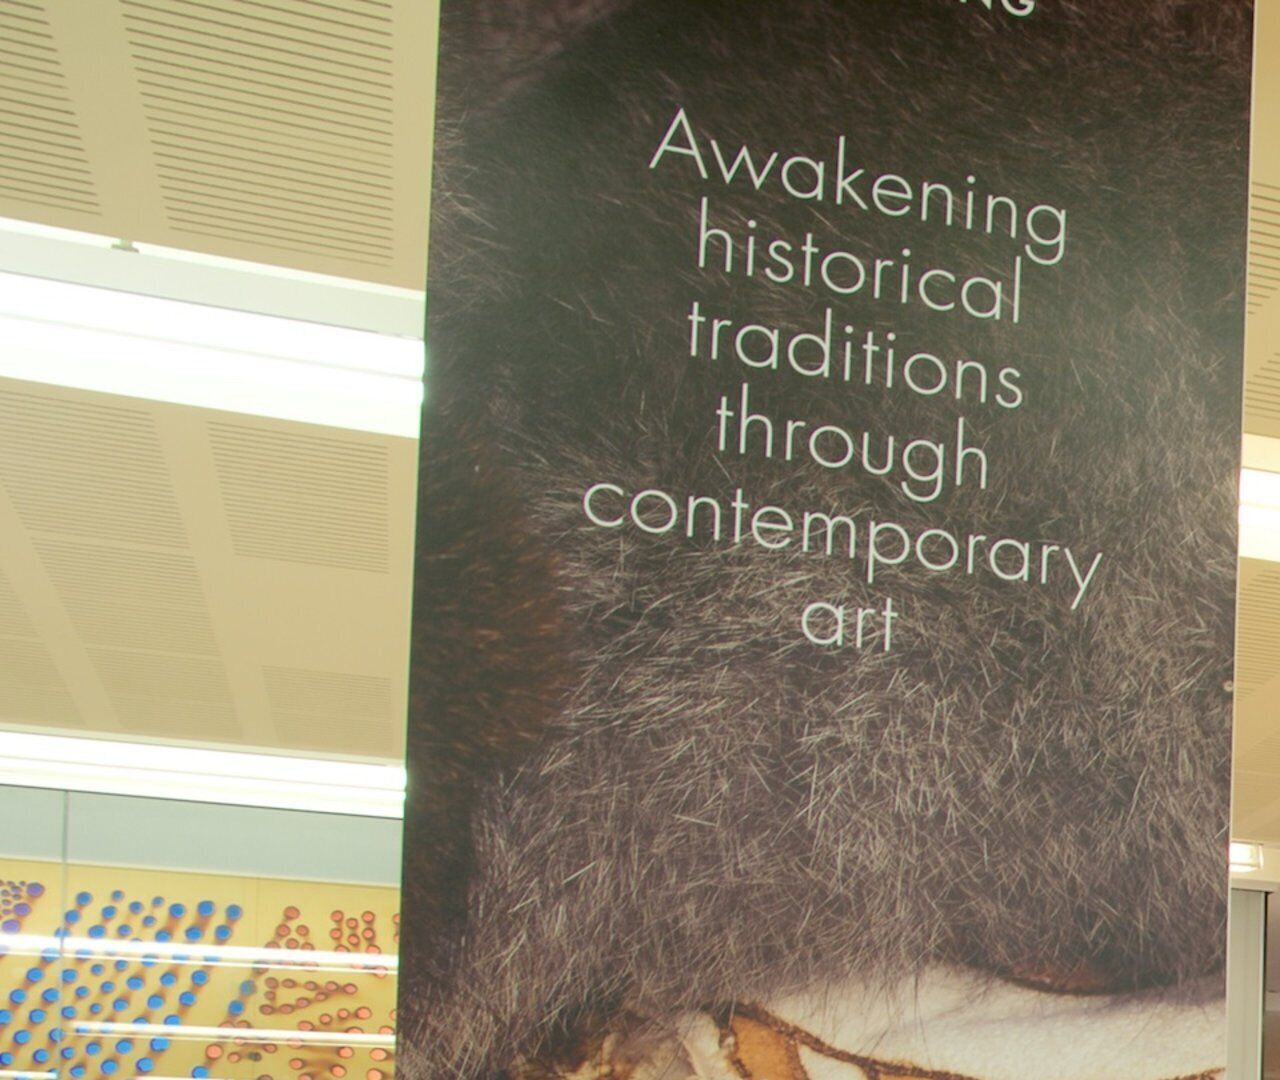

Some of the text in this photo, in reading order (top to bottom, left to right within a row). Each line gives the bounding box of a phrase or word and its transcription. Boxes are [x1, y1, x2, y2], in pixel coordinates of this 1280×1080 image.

[649, 107, 1066, 266] Awakening
[696, 197, 1023, 324] historical
[687, 302, 1023, 408] traditions
[715, 383, 989, 502] through
[582, 482, 1102, 610] contemporary
[801, 597, 899, 651] art
